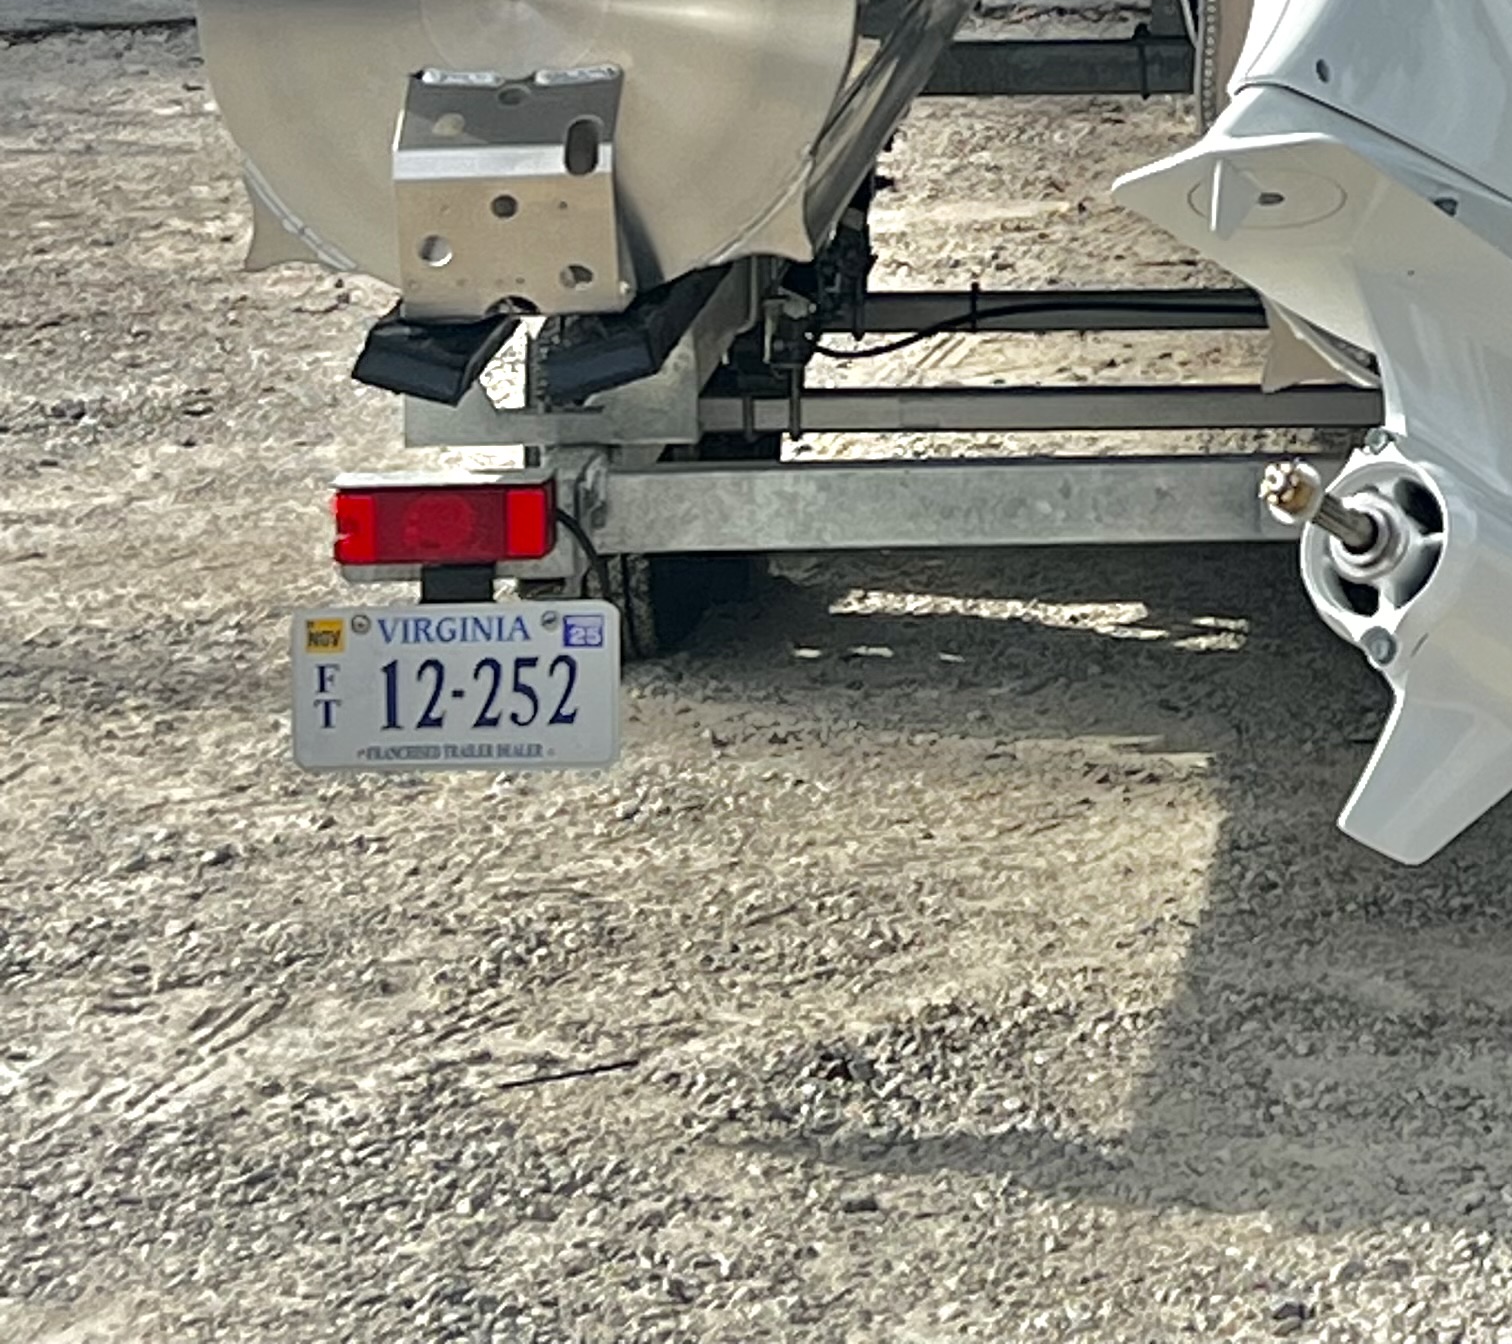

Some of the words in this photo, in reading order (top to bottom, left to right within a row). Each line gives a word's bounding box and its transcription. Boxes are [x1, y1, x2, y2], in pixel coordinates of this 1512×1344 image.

[377, 615, 531, 644] VIRGINIA
[569, 625, 602, 645] 25
[380, 654, 579, 731] 12-252
[496, 742, 544, 758] DEALER
